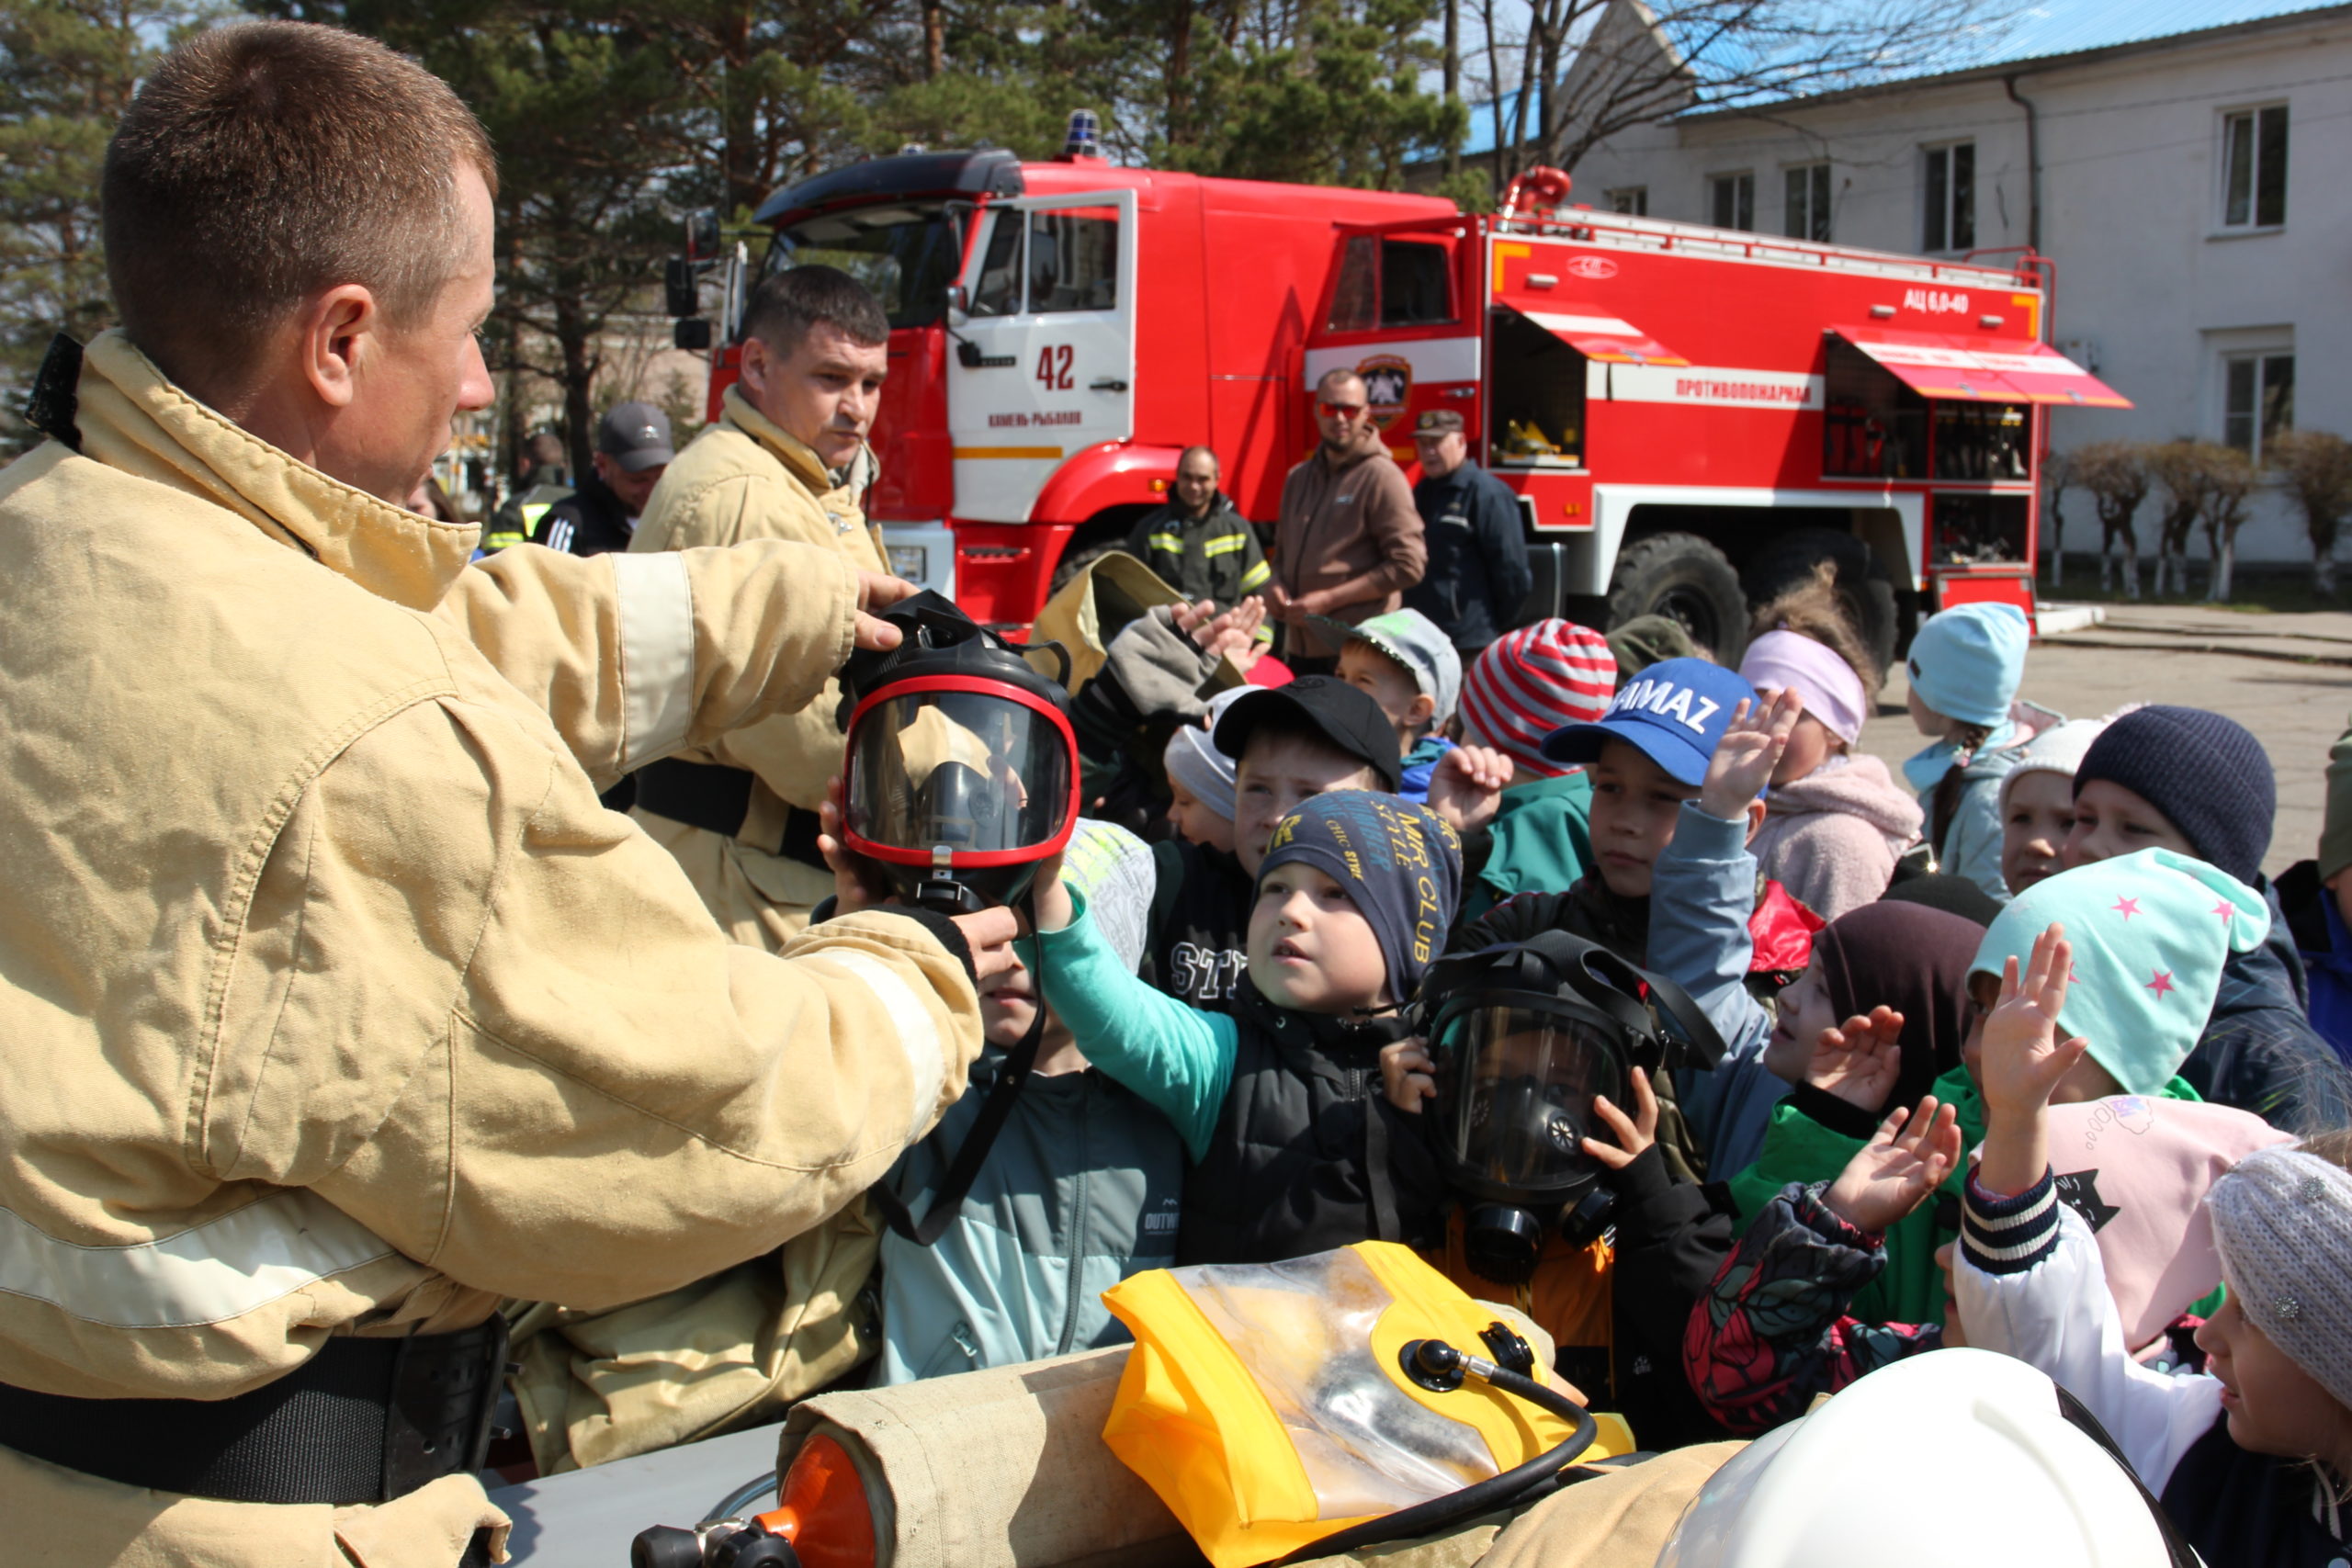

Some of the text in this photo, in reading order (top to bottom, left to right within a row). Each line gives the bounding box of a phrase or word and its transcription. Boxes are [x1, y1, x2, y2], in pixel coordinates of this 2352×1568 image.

[1904, 288, 1926, 314] АЦ
[1036, 345, 1074, 390] 42
[1677, 378, 1811, 402] ПРОТИВОПОЖАРНАЯ
[1606, 679, 1720, 735] AMAZ
[1326, 819, 1351, 848] CHIC
[1370, 800, 1413, 871] STYLE
[1413, 875, 1437, 963] CLUB
